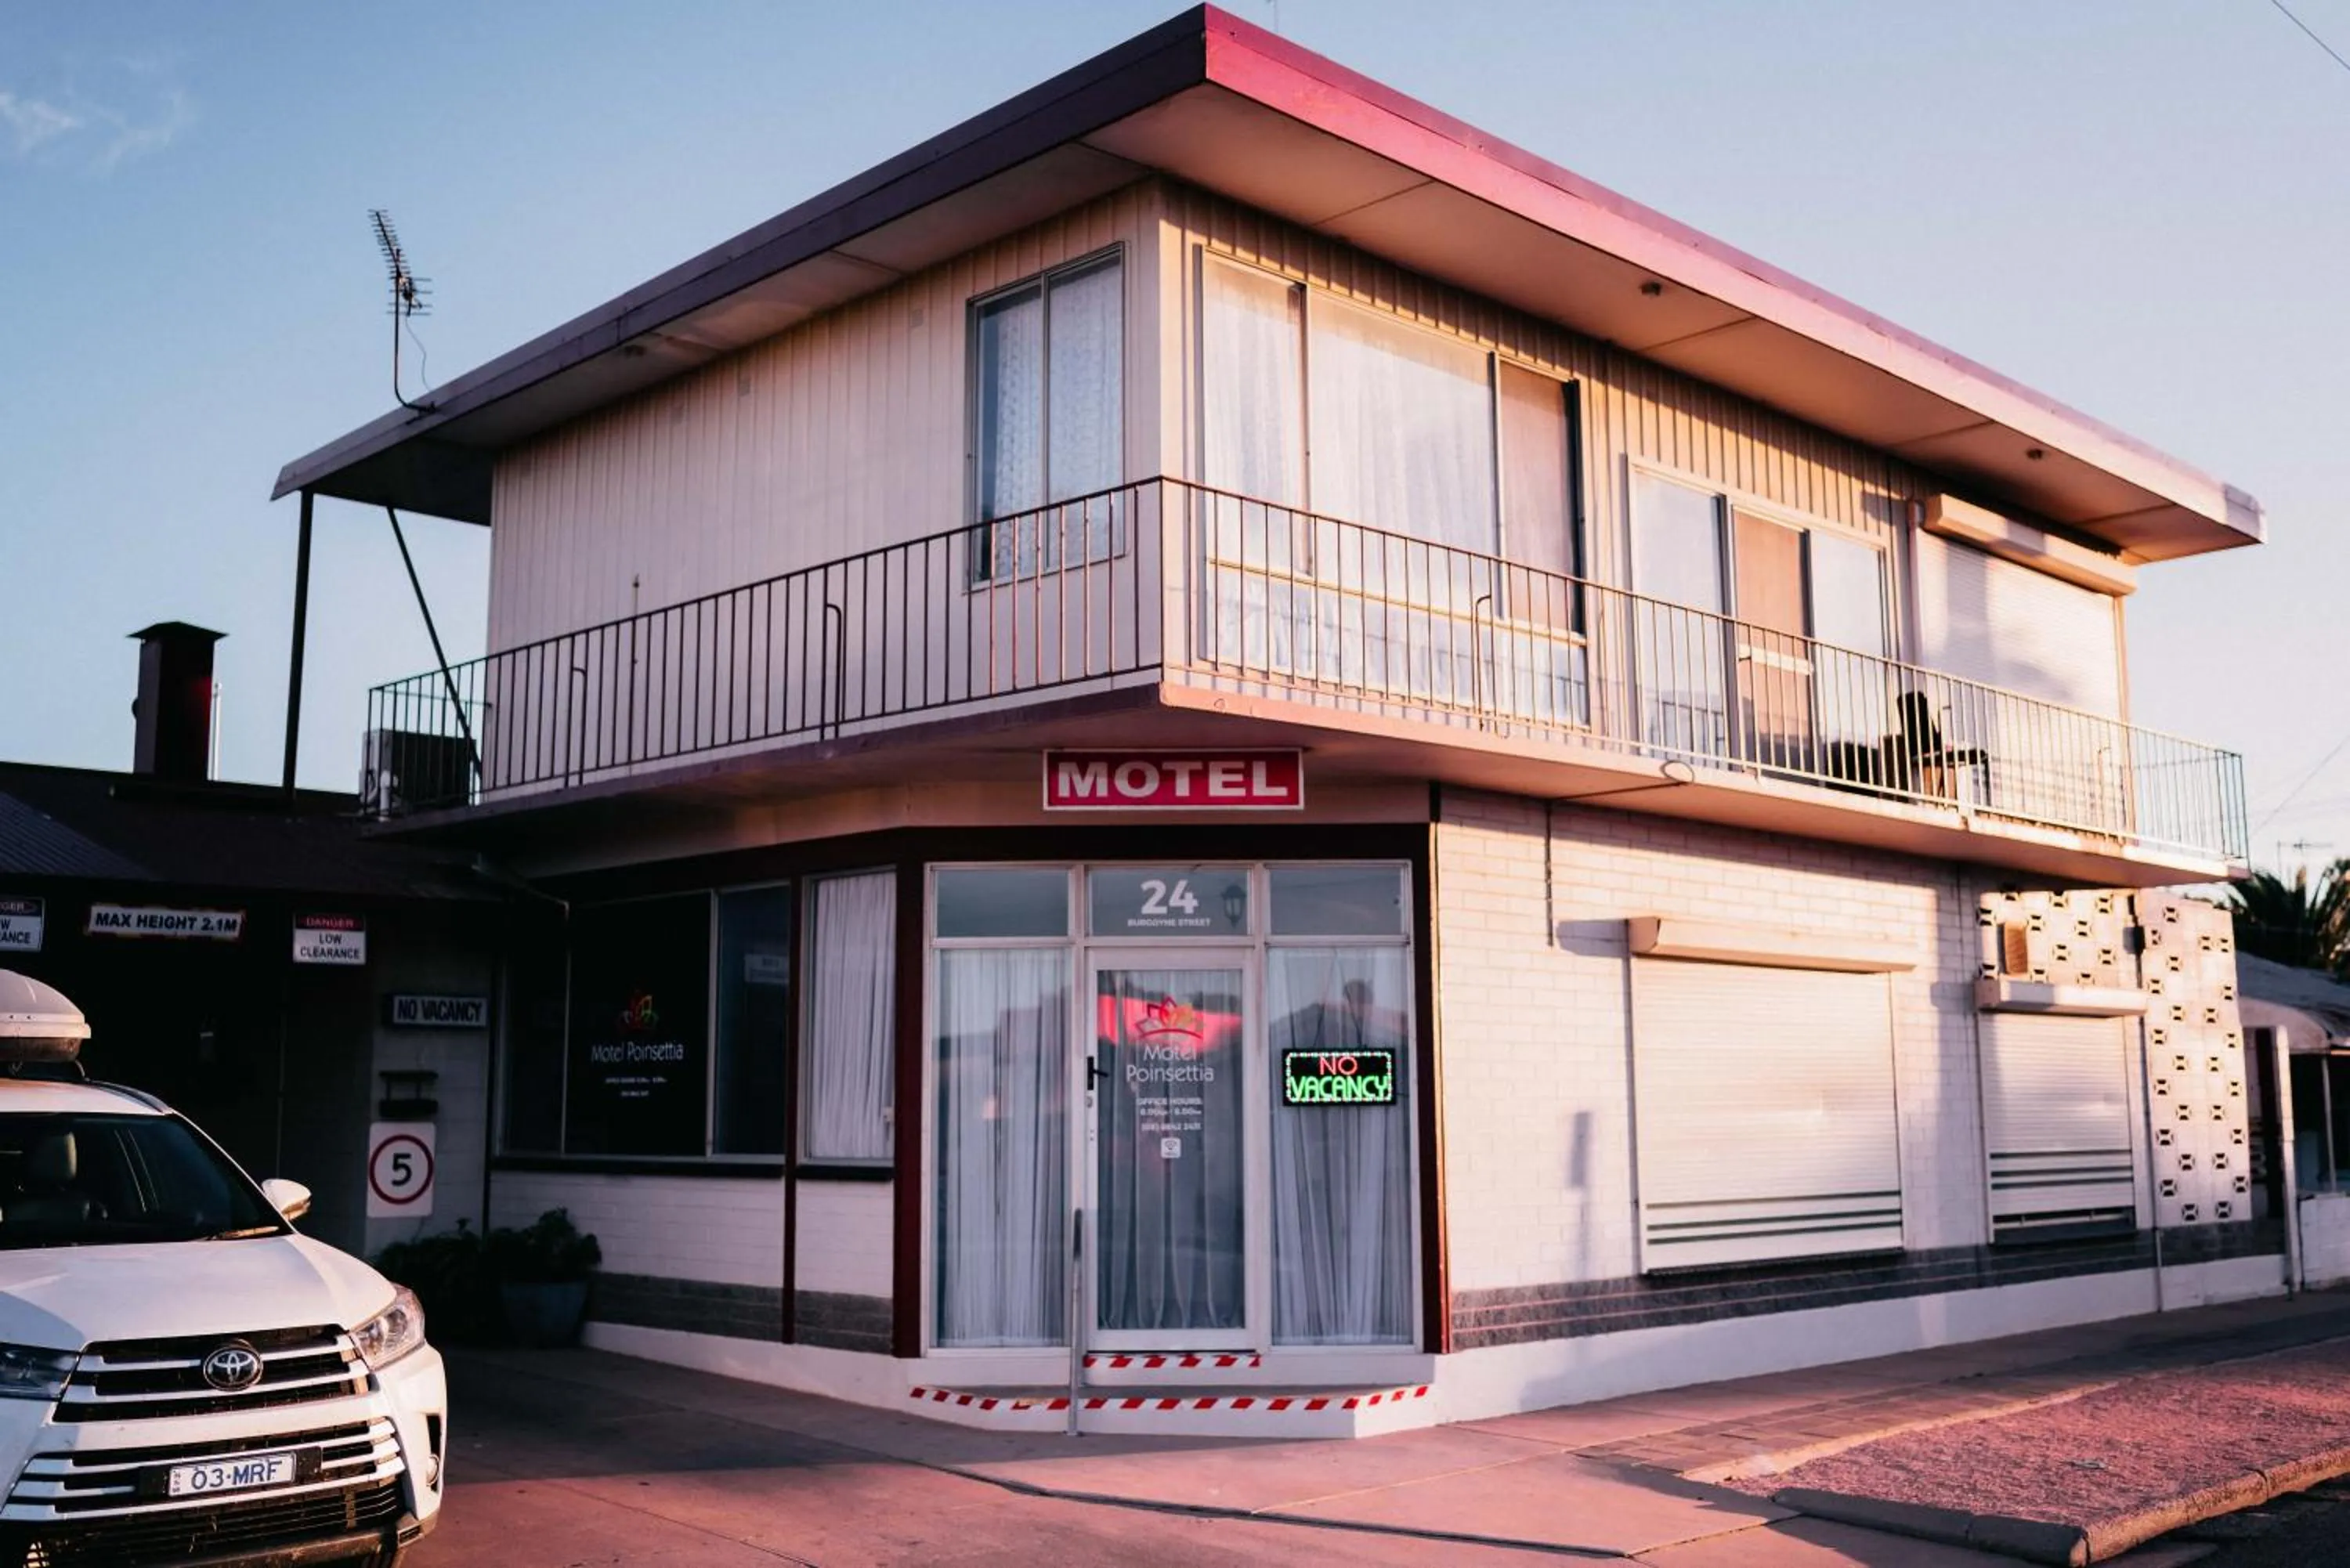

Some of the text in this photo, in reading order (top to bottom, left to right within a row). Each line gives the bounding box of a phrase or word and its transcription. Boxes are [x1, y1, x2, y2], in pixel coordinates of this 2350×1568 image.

[1057, 761, 1289, 798] MOTEL
[1140, 879, 1199, 915] 24
[95, 912, 237, 932] MAX HEIGHT 2.1M
[306, 917, 354, 927] DANGER
[319, 932, 342, 945] LOW
[300, 946, 360, 959] CLEARANCE
[398, 999, 483, 1022] NO VACANCY
[591, 1041, 684, 1062] Motel Poinsettia
[1143, 1043, 1197, 1061] Motel
[1126, 1063, 1215, 1082] Poinsettia
[1320, 1055, 1358, 1075] NO
[1289, 1075, 1388, 1100] VACANCY
[392, 1152, 413, 1187] 5
